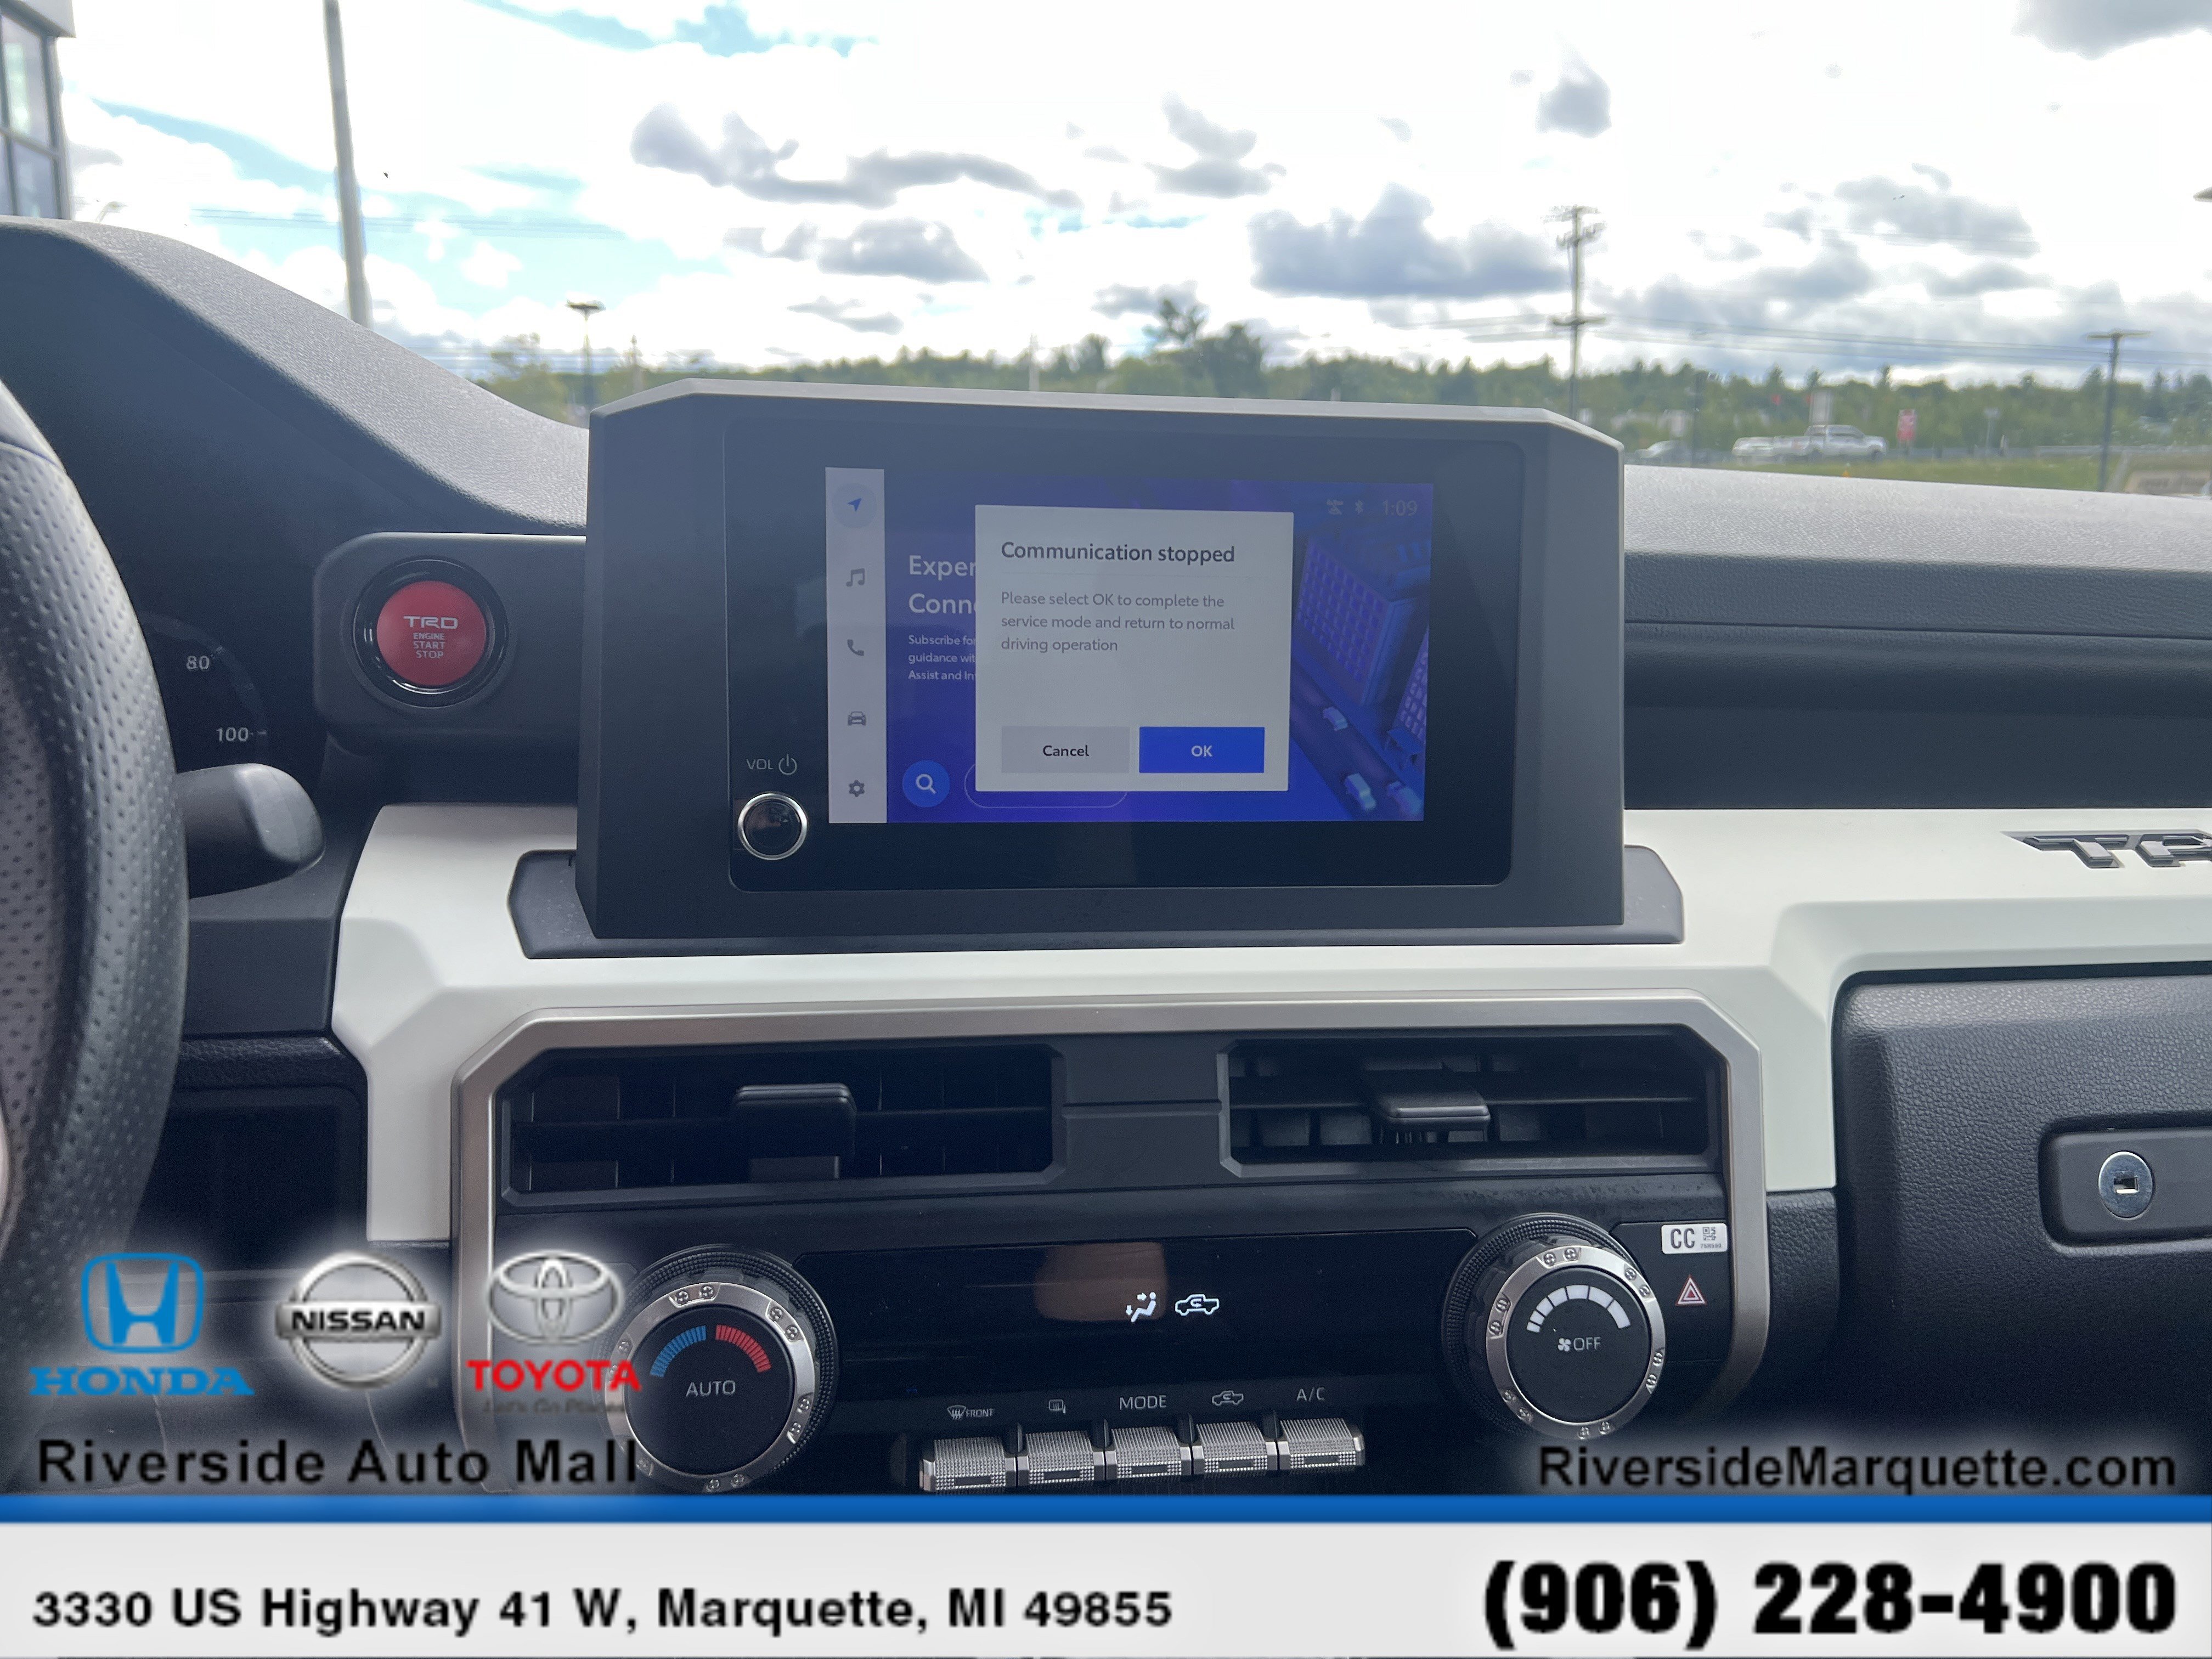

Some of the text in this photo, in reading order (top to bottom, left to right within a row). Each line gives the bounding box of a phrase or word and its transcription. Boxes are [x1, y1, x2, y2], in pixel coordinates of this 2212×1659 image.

[1383, 500, 1418, 516] 1:09
[1001, 541, 1235, 566] Communication stopped
[909, 592, 976, 614] Conn
[1001, 591, 1224, 610] Please select OK to complete the
[403, 616, 458, 629] TRD
[1001, 615, 1234, 630] service mode and return to normal
[413, 641, 445, 650] START
[908, 635, 961, 645] Subscribe
[1001, 637, 1118, 653] driving operation
[415, 650, 444, 658] STOP
[908, 652, 958, 664] guidance
[186, 656, 210, 671] 80
[908, 670, 940, 680] Assist
[941, 670, 961, 680] and
[216, 727, 250, 742] 100
[1042, 744, 1090, 757] Cancel
[1190, 745, 1213, 757] OK
[746, 759, 774, 770] VOL
[1671, 1228, 1695, 1249] CC
[1573, 1336, 1601, 1351] OFF
[685, 1380, 736, 1397] AUTO
[1296, 1387, 1327, 1401] A/C
[1120, 1395, 1167, 1410] MODE
[966, 1408, 994, 1417] FRONT
